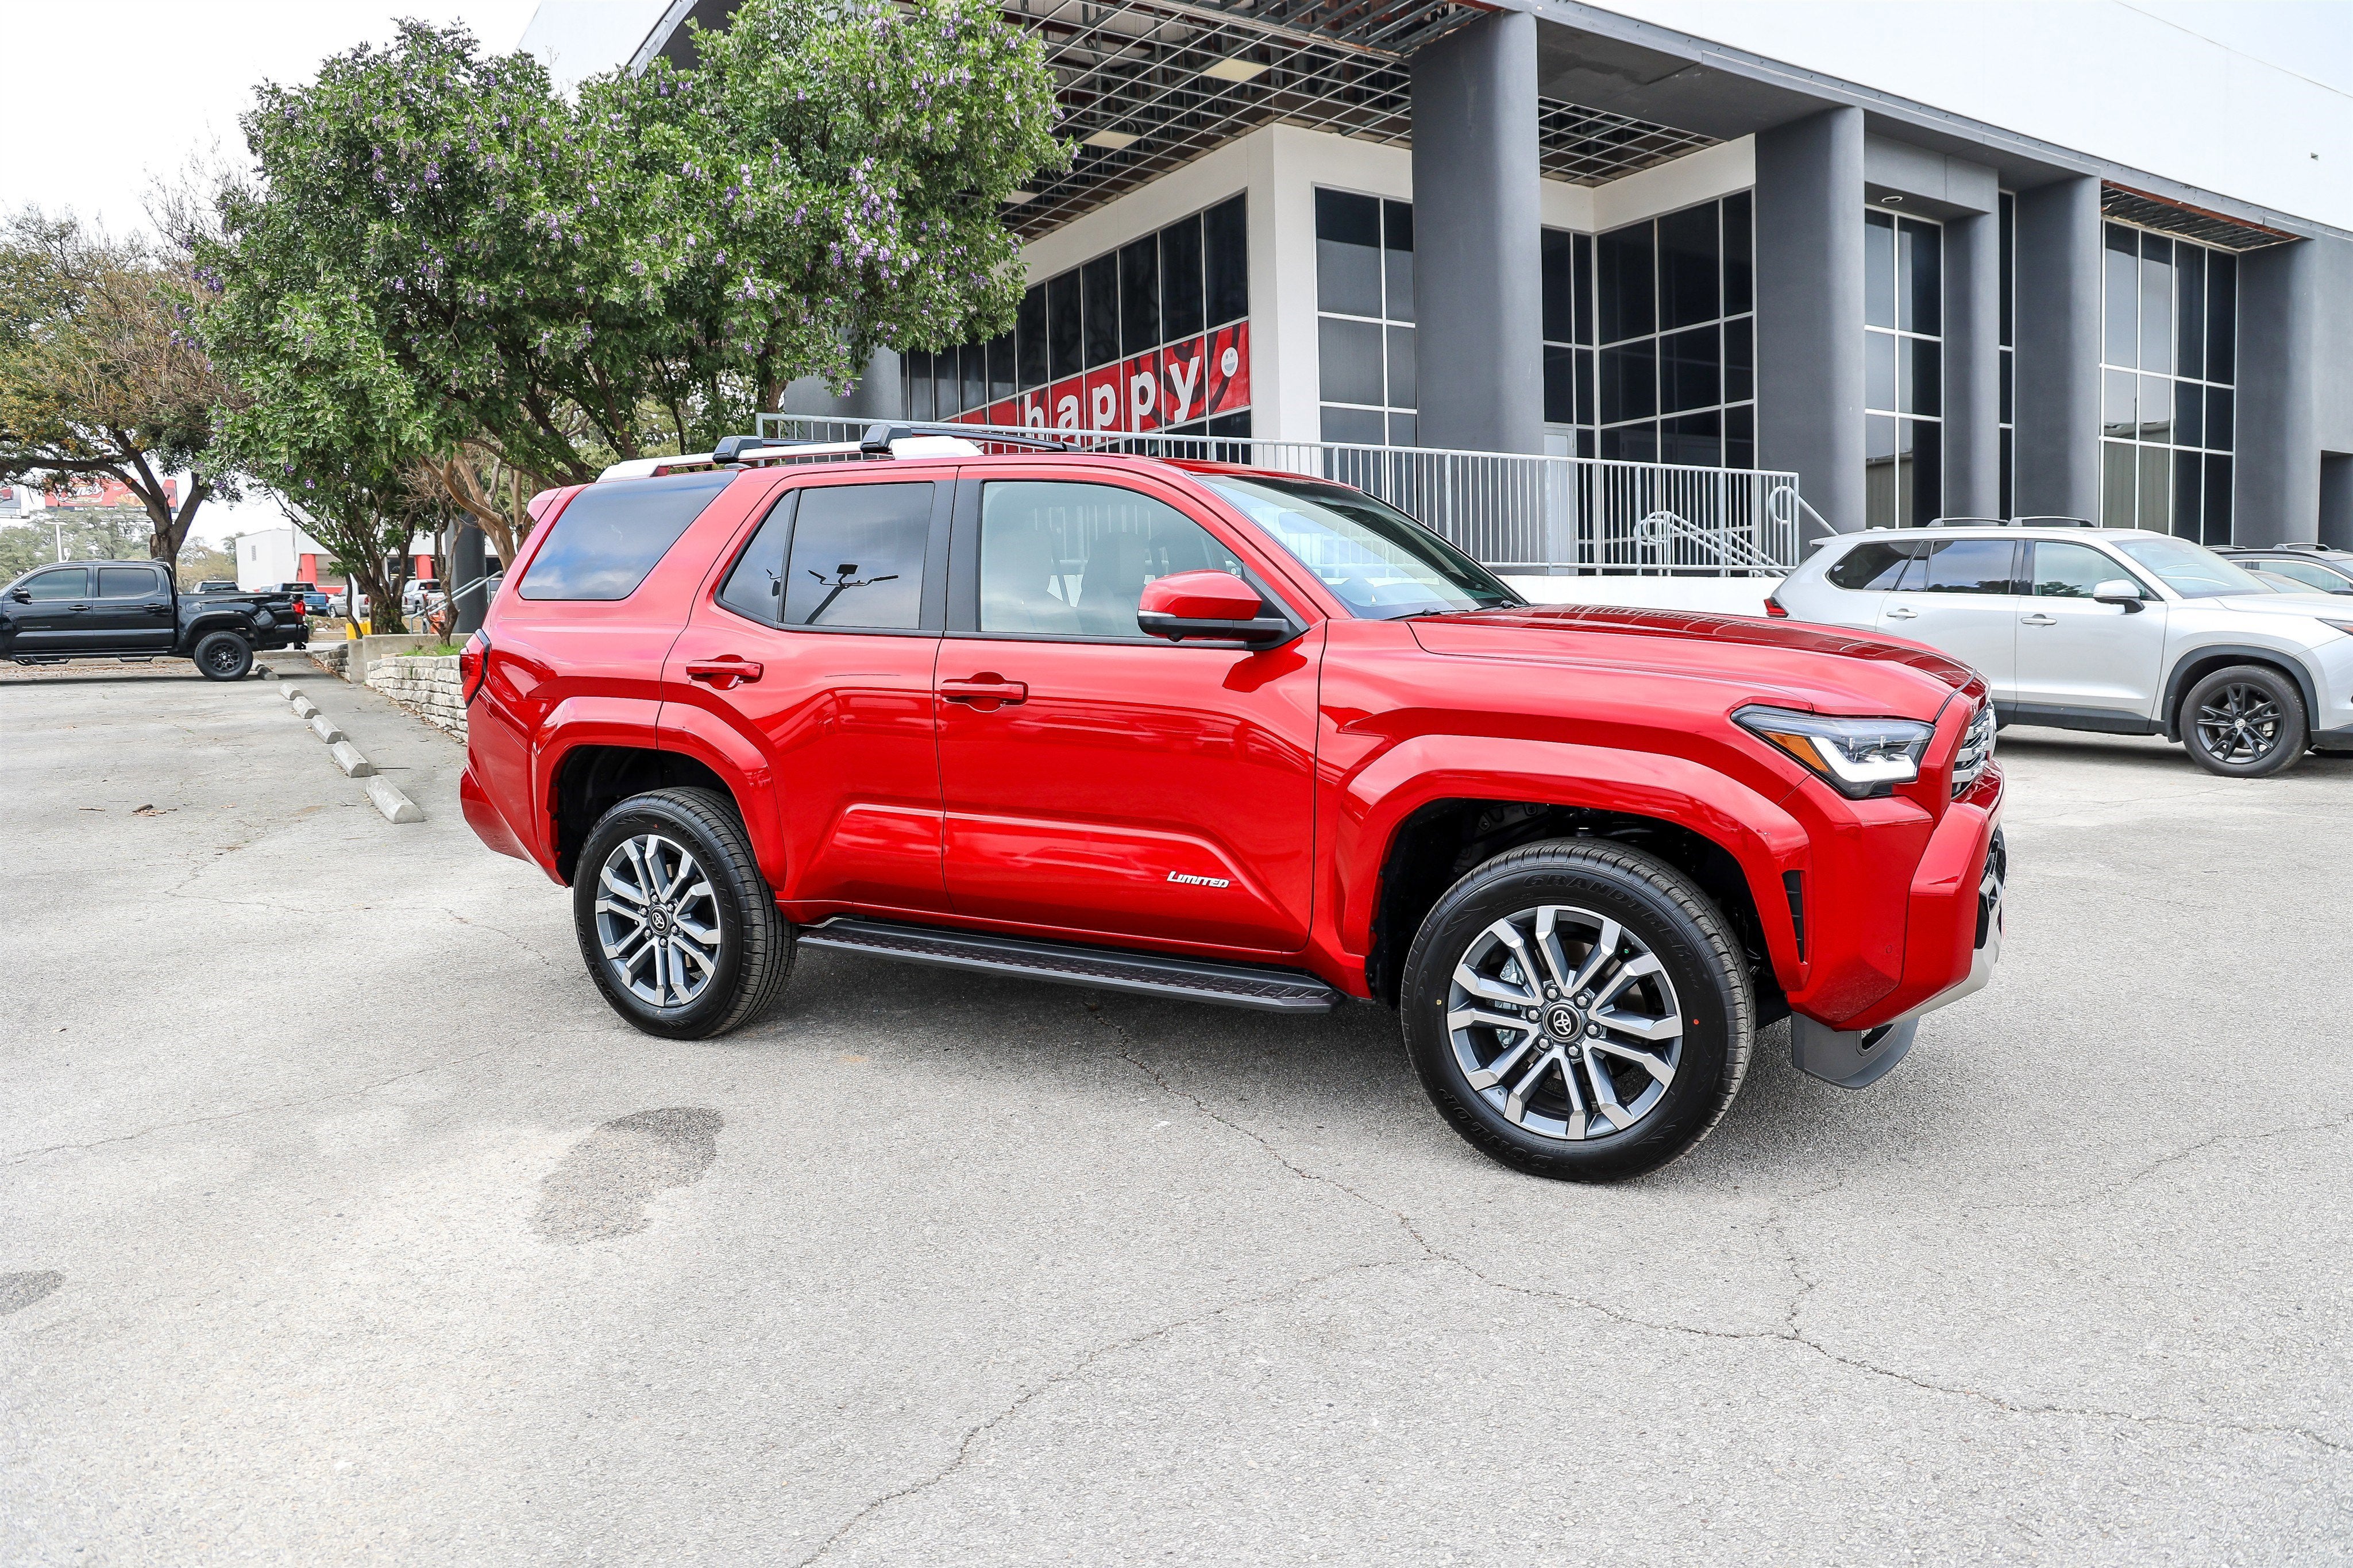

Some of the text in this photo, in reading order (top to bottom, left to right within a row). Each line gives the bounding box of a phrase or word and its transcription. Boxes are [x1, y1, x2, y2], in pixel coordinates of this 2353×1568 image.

[1024, 356, 1200, 443] happy
[1522, 873, 1696, 963] GRANDTREK
[1438, 1088, 1554, 1169] DUNLOP
